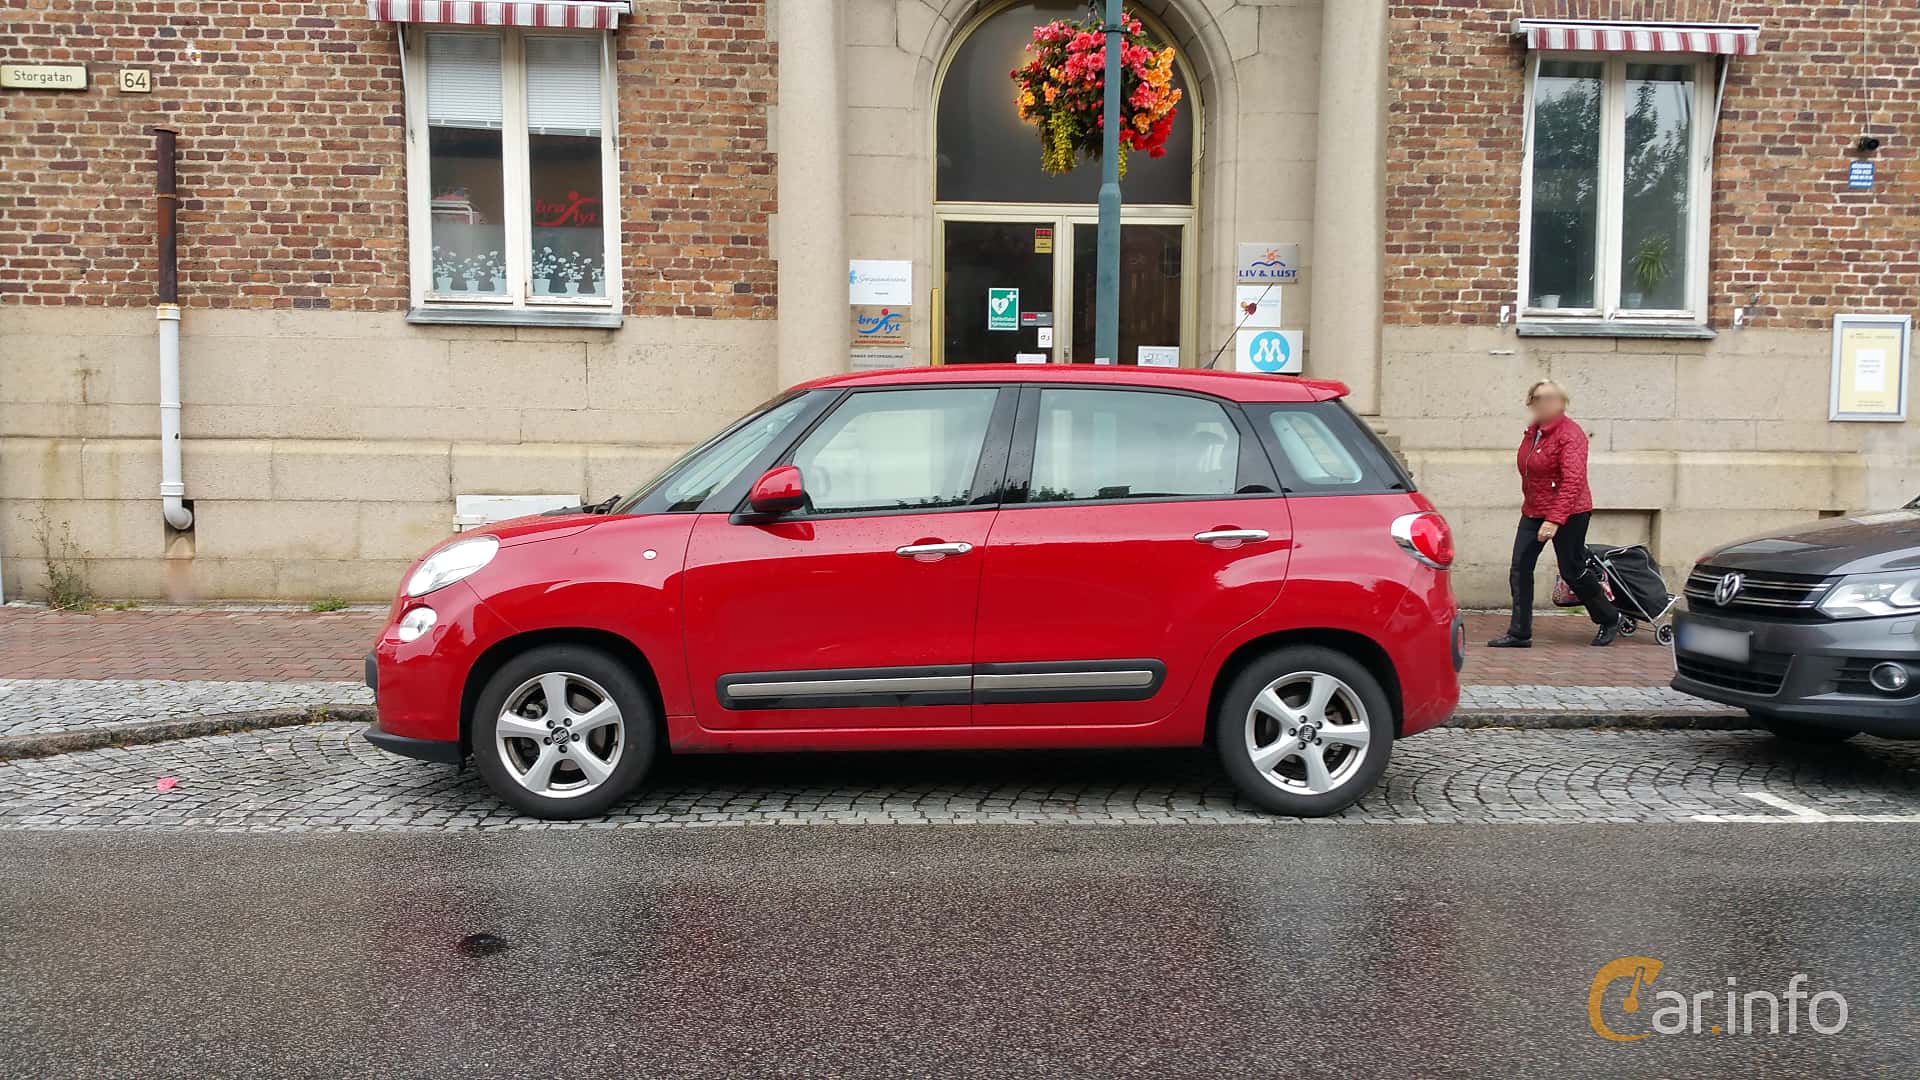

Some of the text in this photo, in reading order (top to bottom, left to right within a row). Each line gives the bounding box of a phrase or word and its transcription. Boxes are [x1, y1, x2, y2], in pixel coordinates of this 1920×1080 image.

[14, 70, 73, 84] Storgatan
[124, 72, 146, 89] 64
[1239, 269, 1297, 278] LIV & LUST
